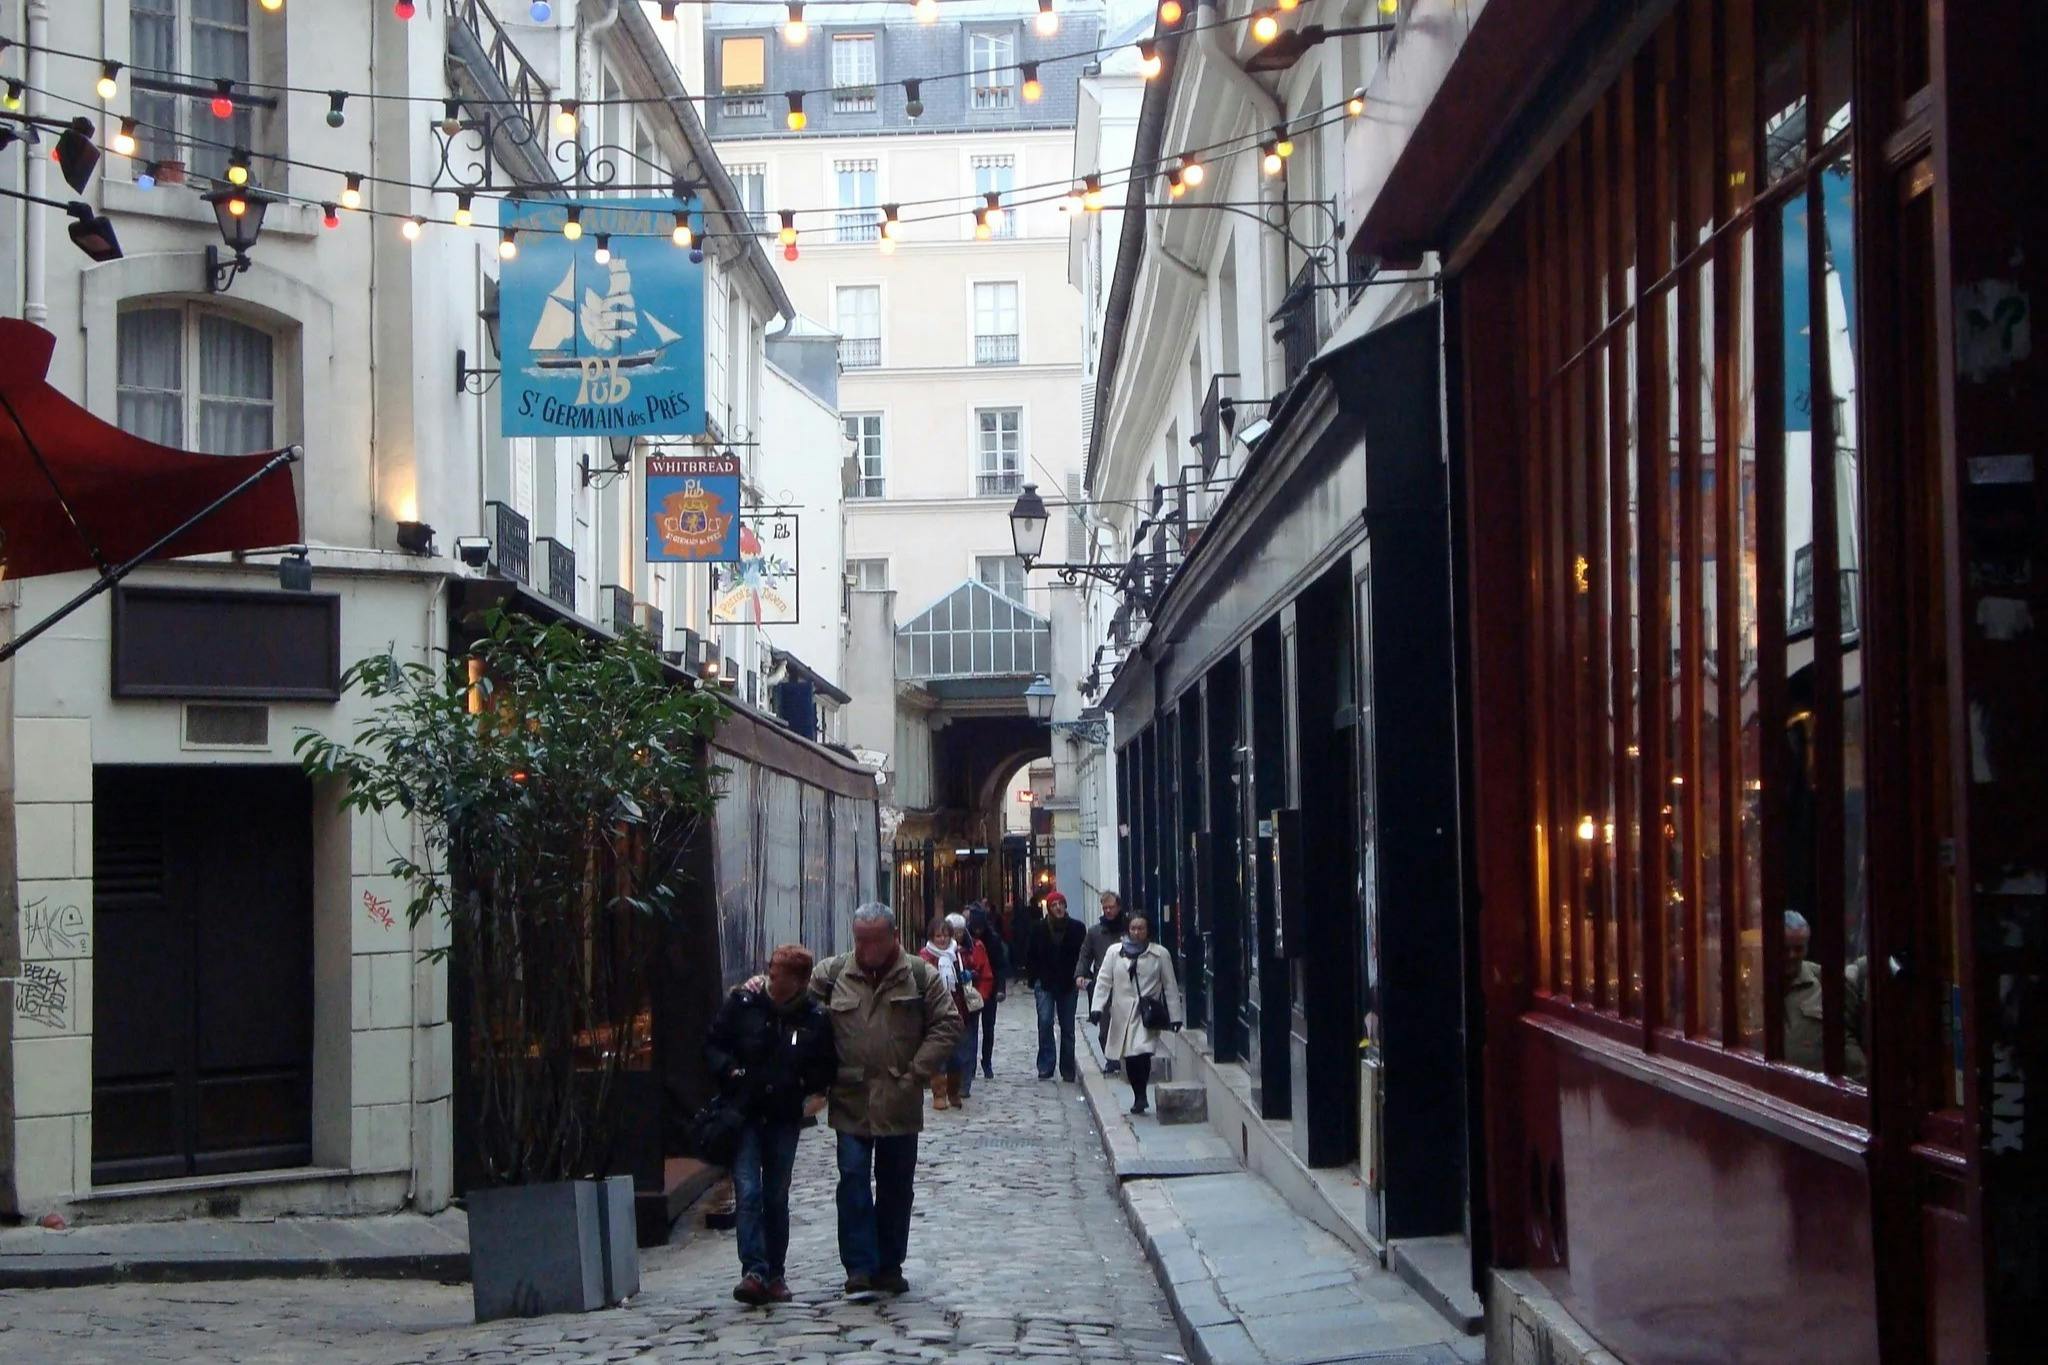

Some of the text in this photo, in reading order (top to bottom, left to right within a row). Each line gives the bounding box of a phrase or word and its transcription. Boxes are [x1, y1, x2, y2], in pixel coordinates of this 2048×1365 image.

[574, 356, 631, 406] Pub
[542, 396, 625, 430] GERMAIN
[627, 409, 646, 427] des
[652, 461, 734, 473] WHITBREAD
[684, 479, 705, 499] Pub
[774, 523, 791, 540] Pub
